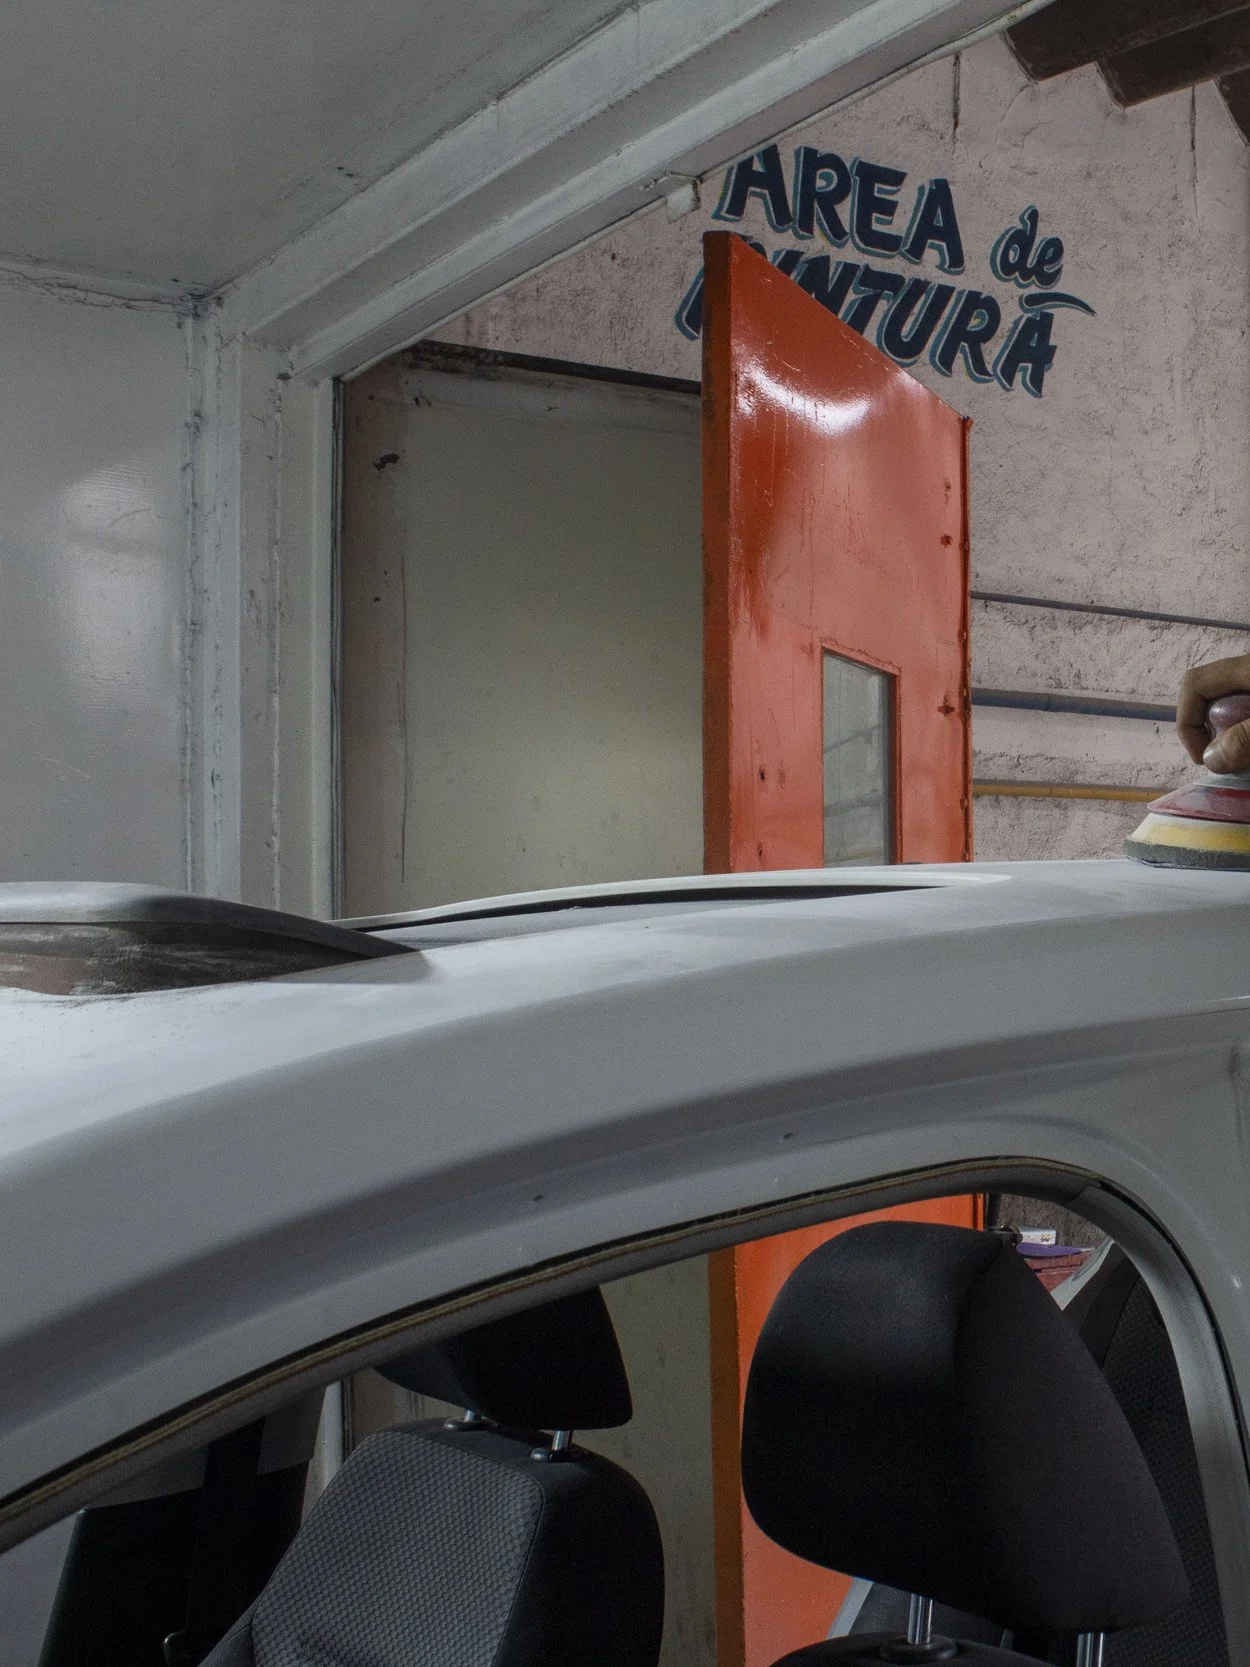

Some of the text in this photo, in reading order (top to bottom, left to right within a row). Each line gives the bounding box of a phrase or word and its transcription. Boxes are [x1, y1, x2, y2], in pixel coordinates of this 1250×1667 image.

[711, 144, 1064, 288] AREA de
[674, 234, 1096, 398] NTURA
